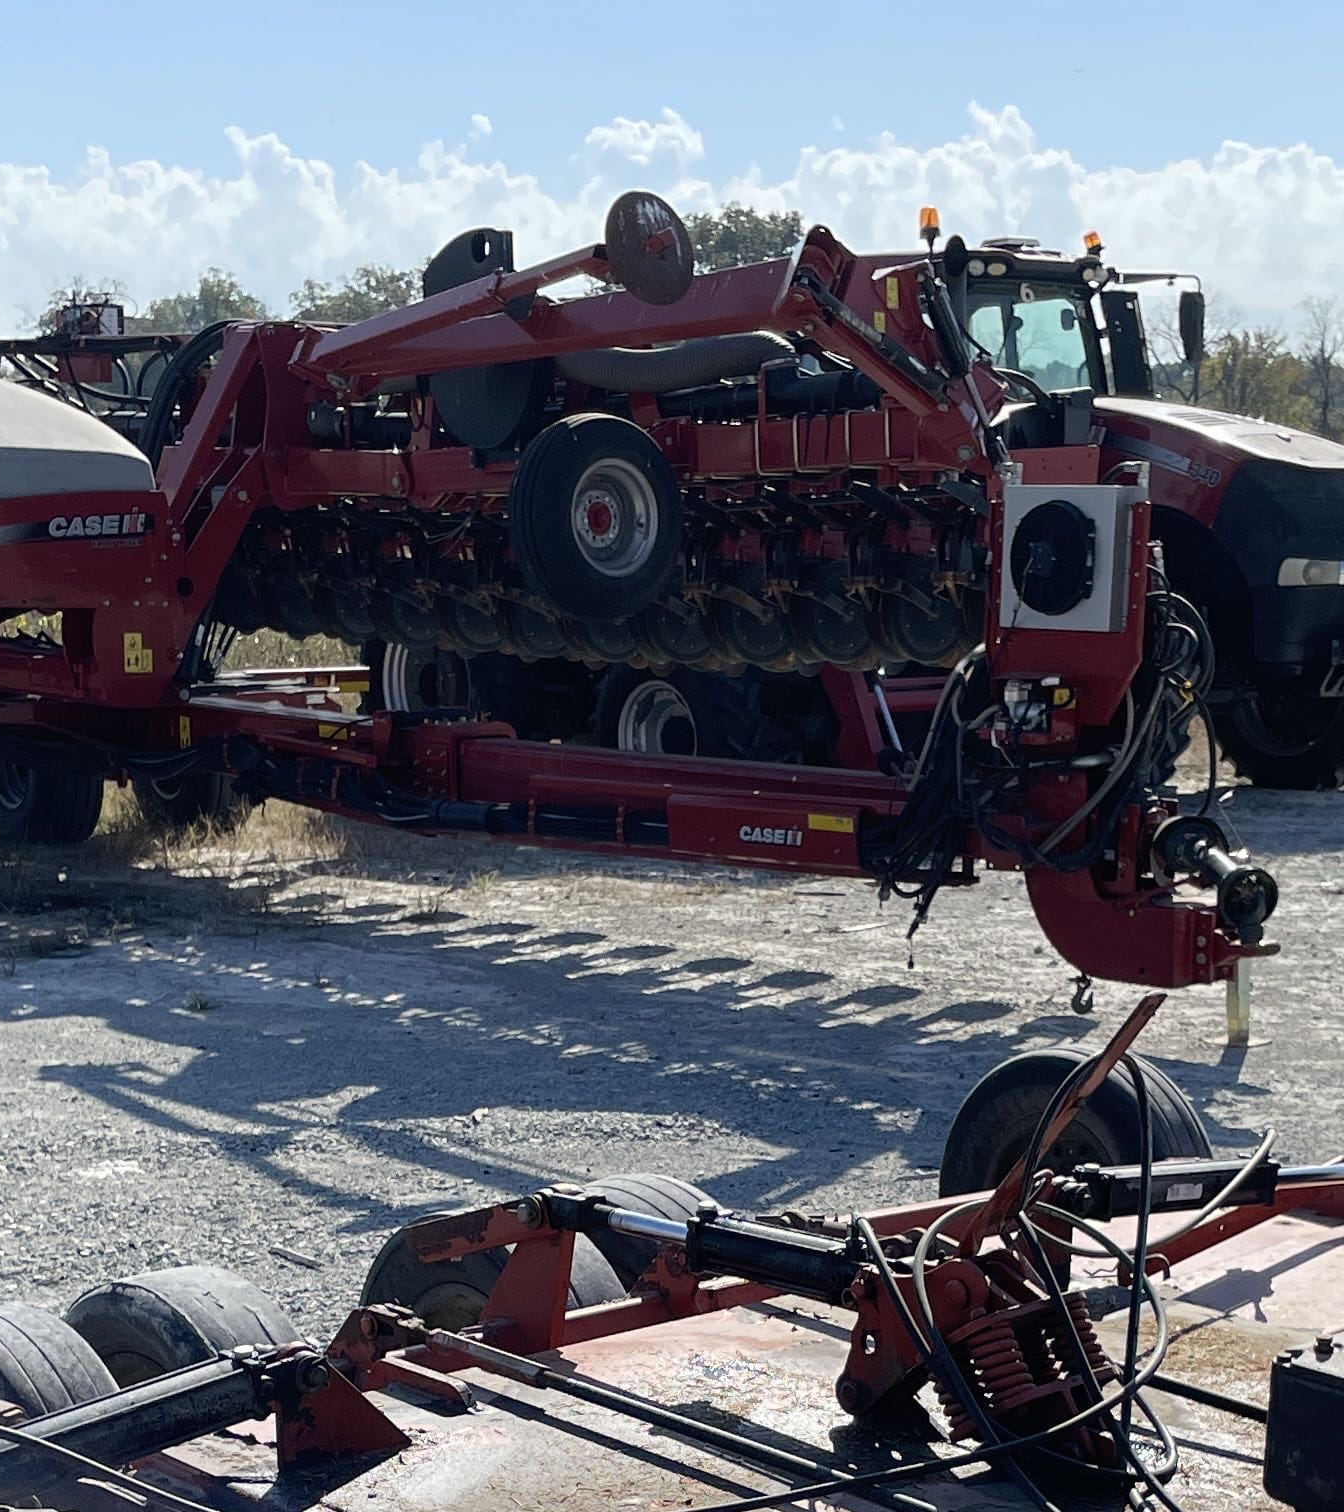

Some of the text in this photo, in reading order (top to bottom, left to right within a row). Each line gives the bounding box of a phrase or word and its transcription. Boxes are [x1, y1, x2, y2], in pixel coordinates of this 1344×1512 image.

[1019, 281, 1036, 304] 6
[48, 514, 121, 538] CASE
[739, 825, 786, 844] CASE
